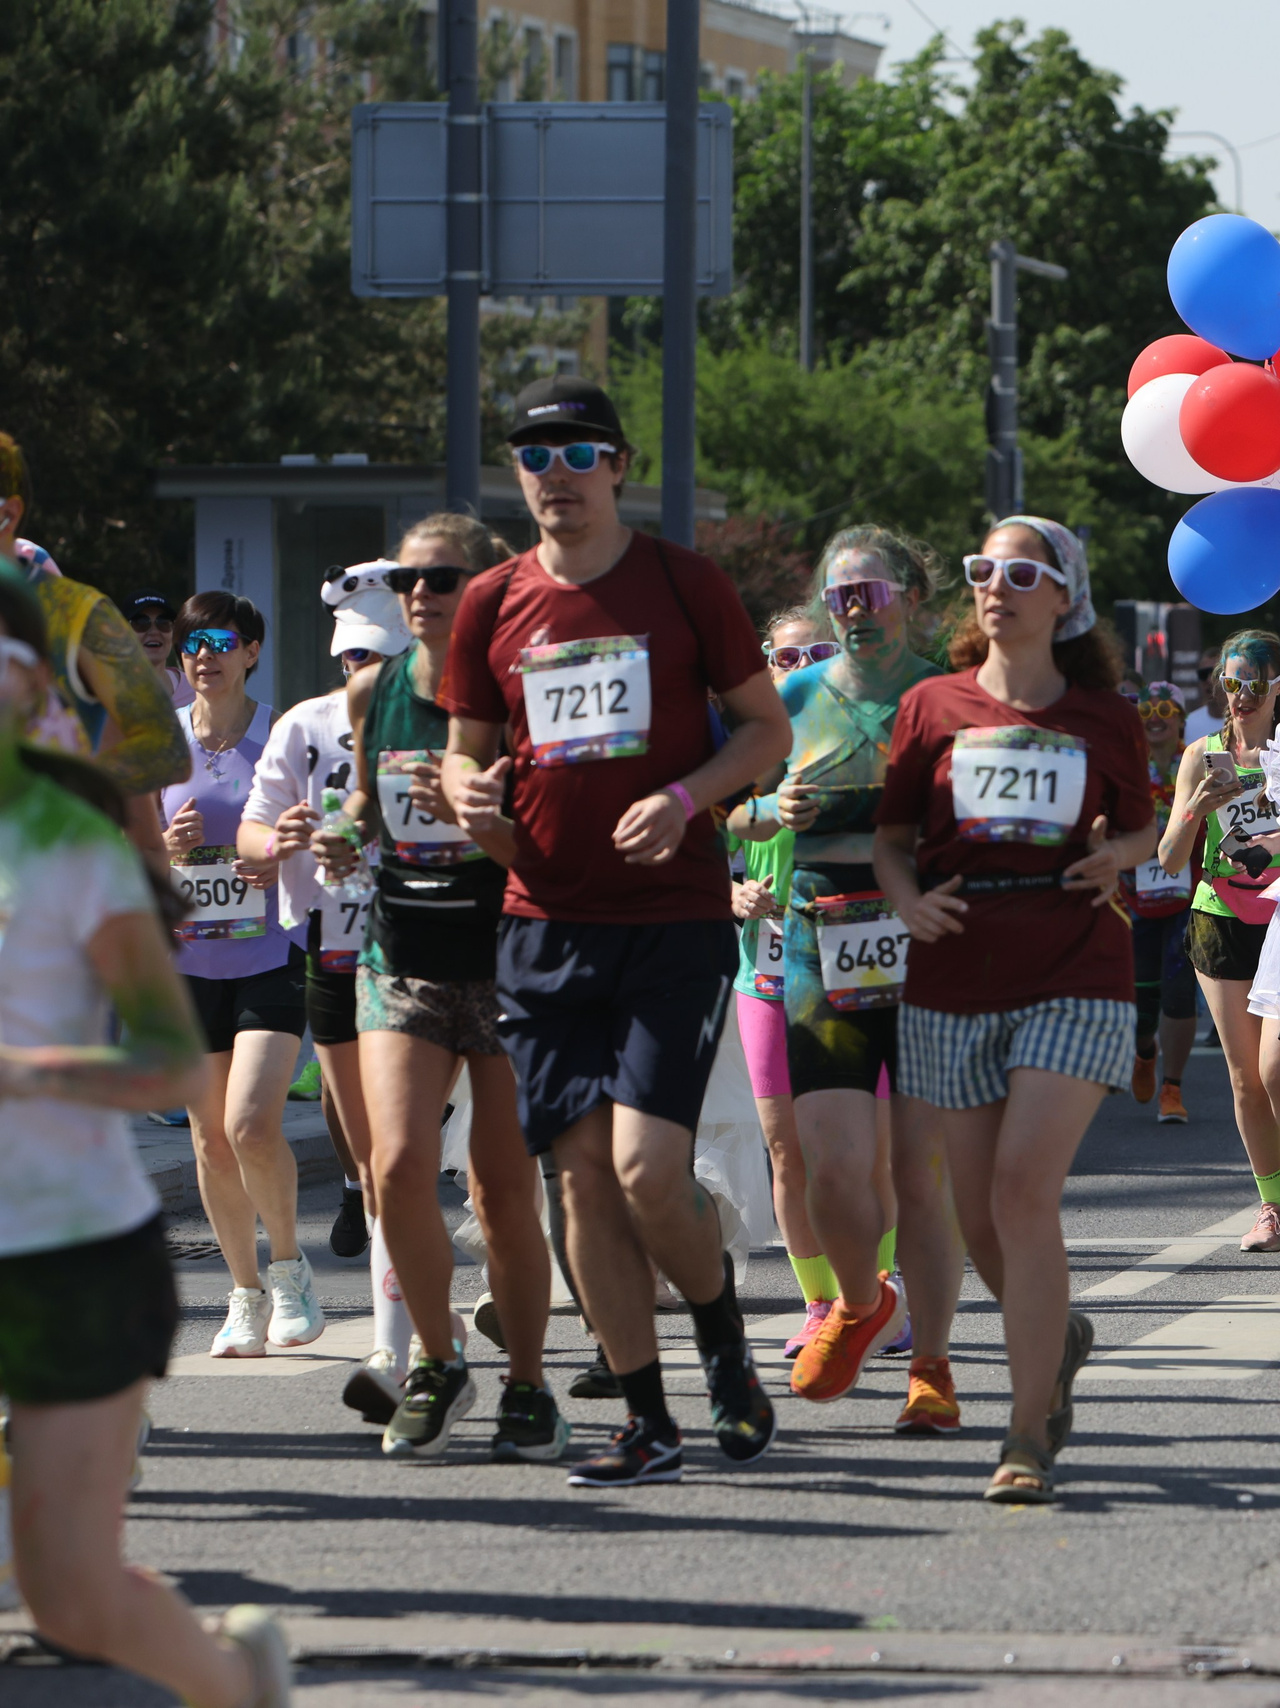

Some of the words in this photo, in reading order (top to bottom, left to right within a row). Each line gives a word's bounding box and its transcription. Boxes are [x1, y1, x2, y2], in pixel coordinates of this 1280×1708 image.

[545, 679, 629, 722] 7212
[975, 765, 1058, 804] 7211
[180, 878, 248, 907] 2509
[836, 932, 911, 973] 6487
